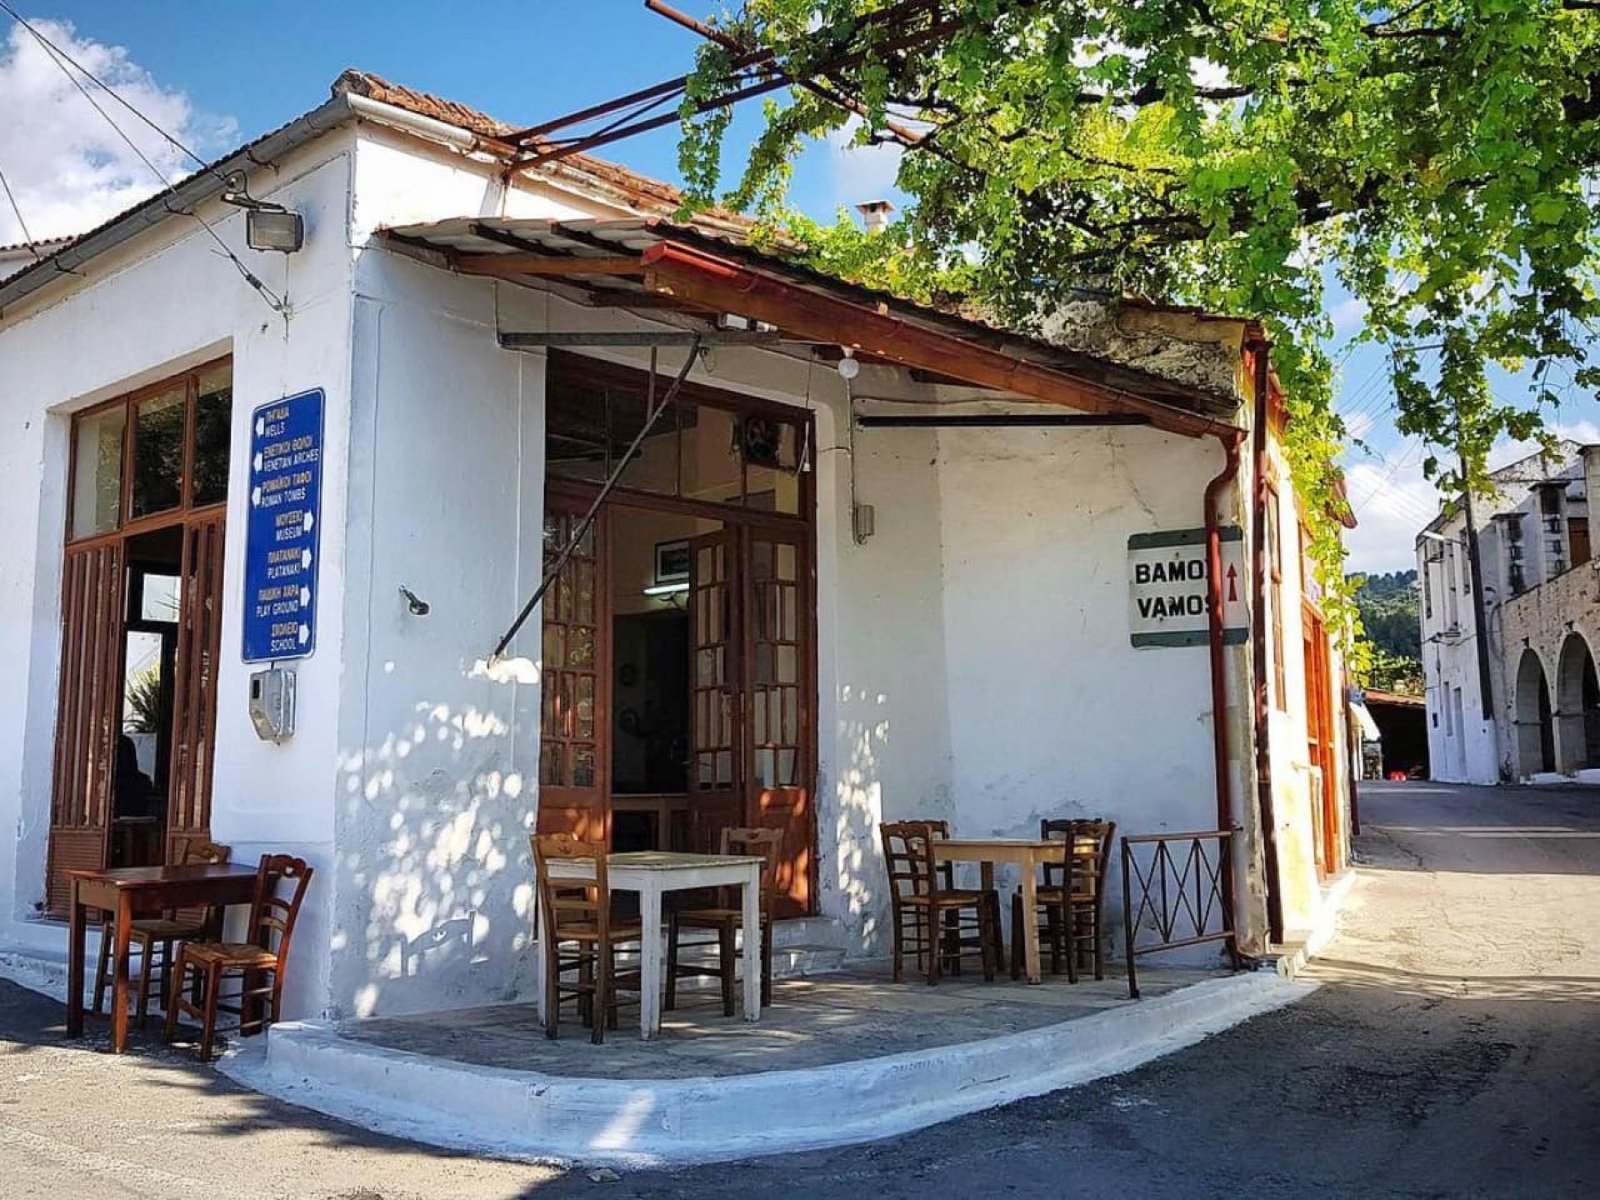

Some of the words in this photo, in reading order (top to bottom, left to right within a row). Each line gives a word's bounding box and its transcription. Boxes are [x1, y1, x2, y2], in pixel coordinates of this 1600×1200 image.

[265, 422, 285, 437] WELLS
[264, 456, 292, 471] VENETIAN
[294, 450, 320, 464] ARCHES
[261, 494, 281, 506] ROMAN
[284, 488, 306, 503] TOMBS
[276, 526, 302, 541] MUSEUM
[1136, 559, 1208, 584] ΒΑΜΟ
[256, 605, 271, 617] PLAY
[272, 600, 299, 614] GROUND
[270, 639, 296, 651] SCHOOL
